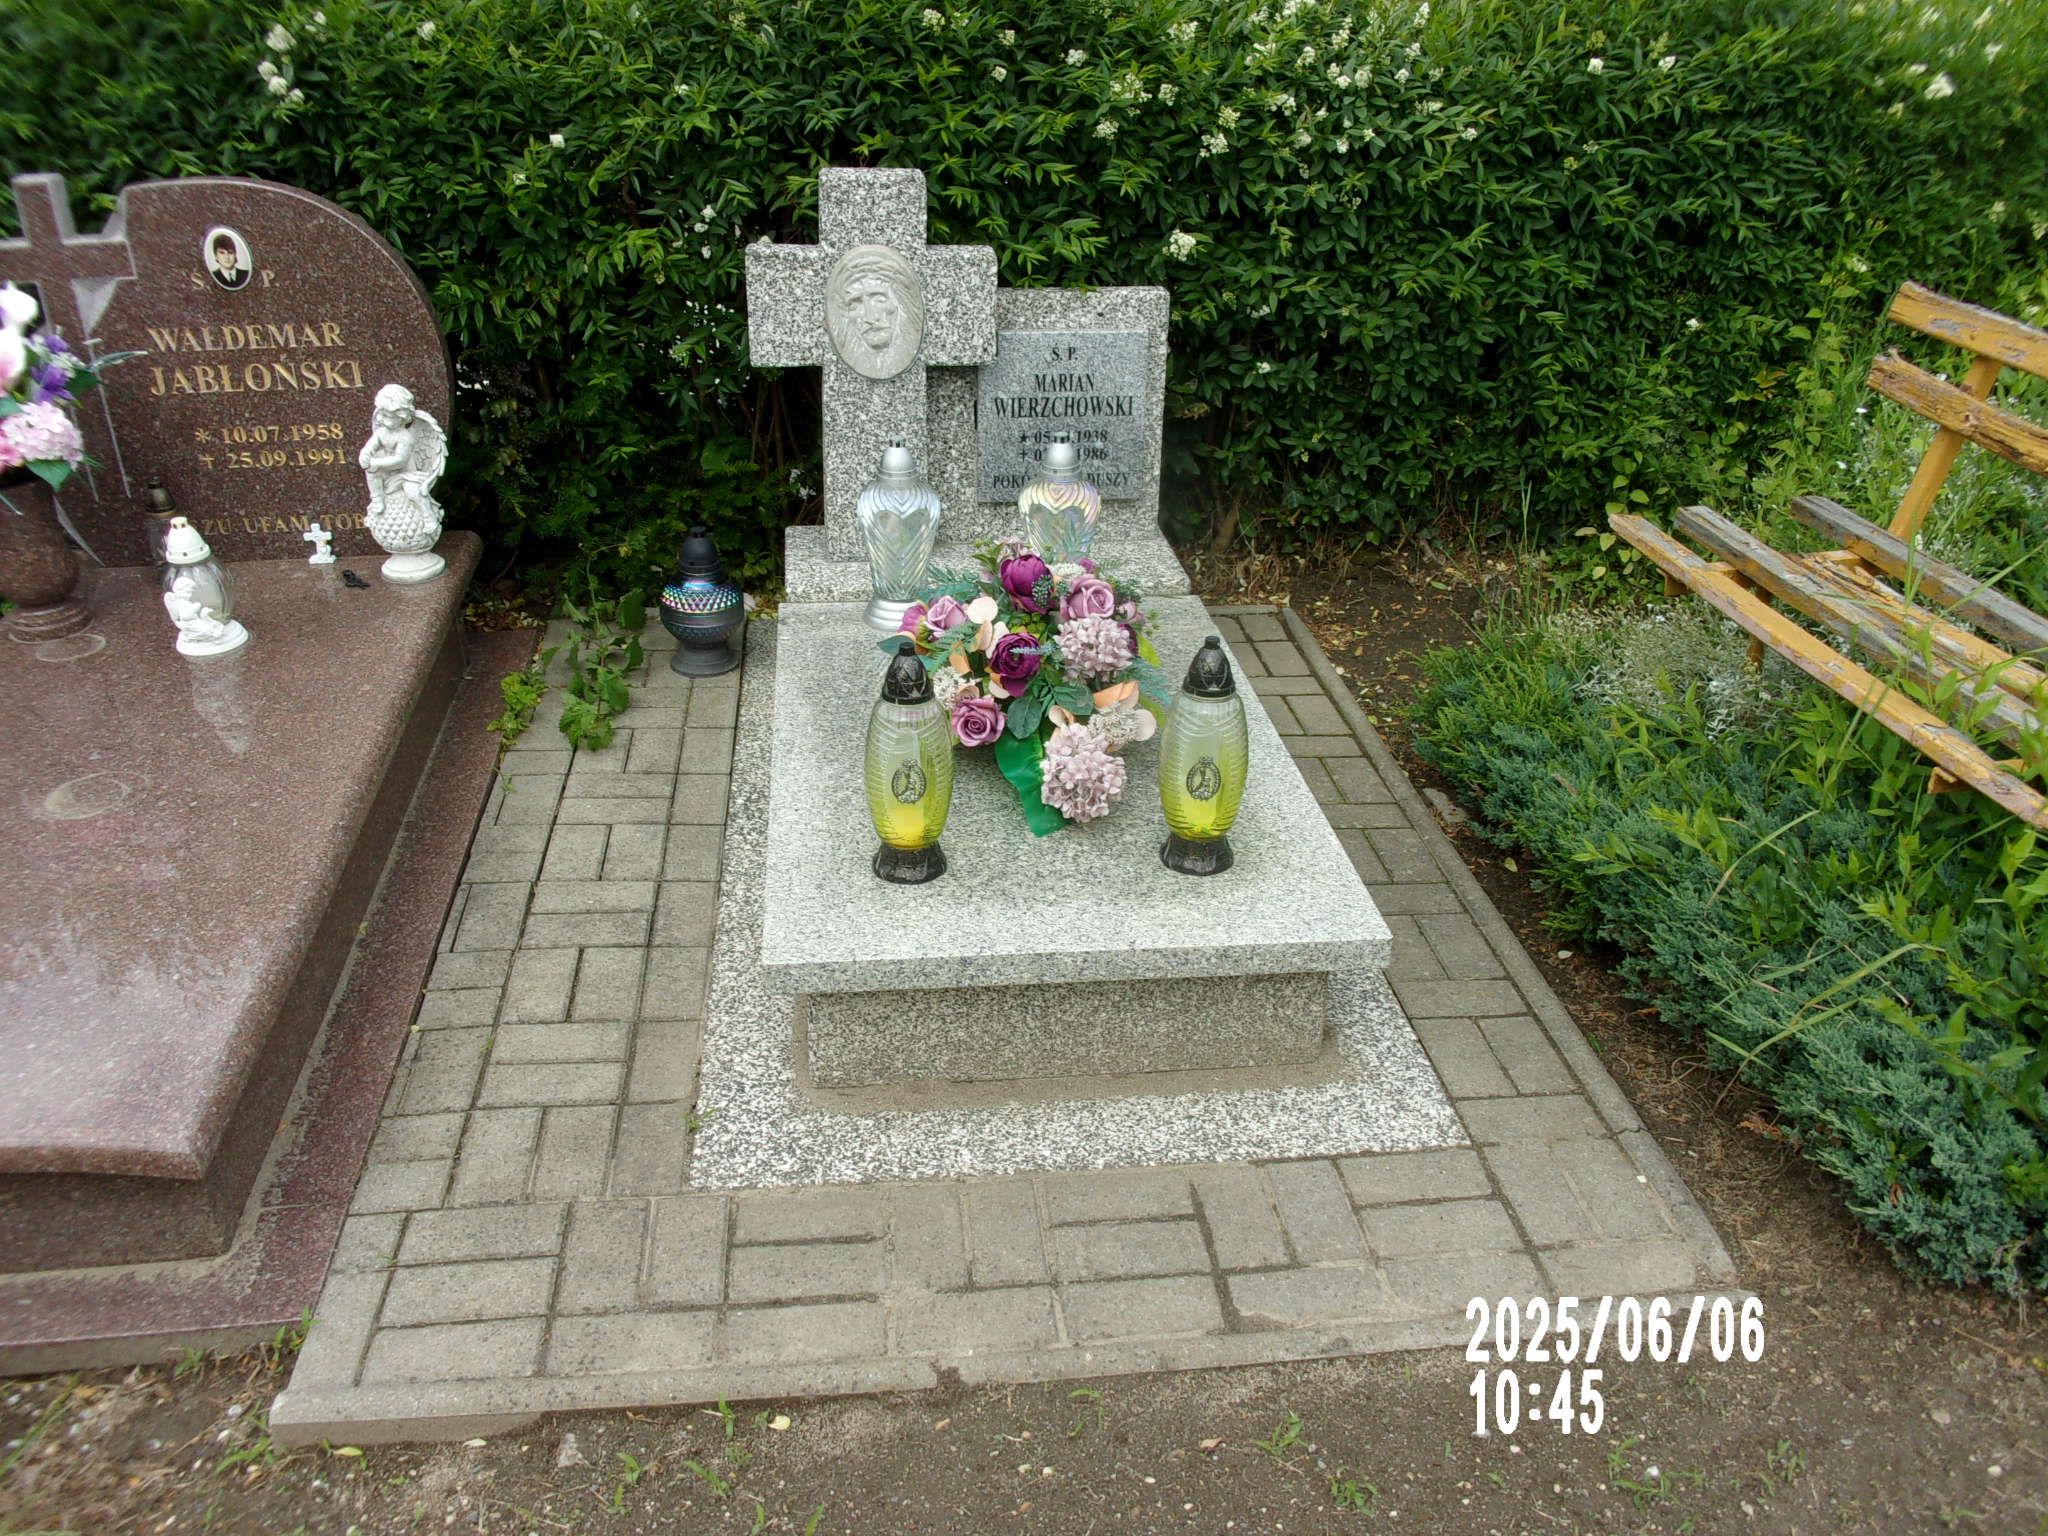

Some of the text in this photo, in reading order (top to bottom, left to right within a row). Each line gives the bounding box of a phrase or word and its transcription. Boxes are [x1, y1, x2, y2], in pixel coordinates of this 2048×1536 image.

[147, 322, 346, 352] WALDEMAR
[150, 353, 365, 396] JABŁOŃSKI
[1034, 373, 1095, 392] MARIAN
[994, 396, 1134, 419] WIERZCHOWSKI
[222, 422, 344, 444] 10.07.1958
[227, 448, 347, 469] 25.09.1991
[993, 469, 1031, 489] POKÓ
[243, 512, 310, 534] UFAM
[320, 512, 366, 531] TOB
